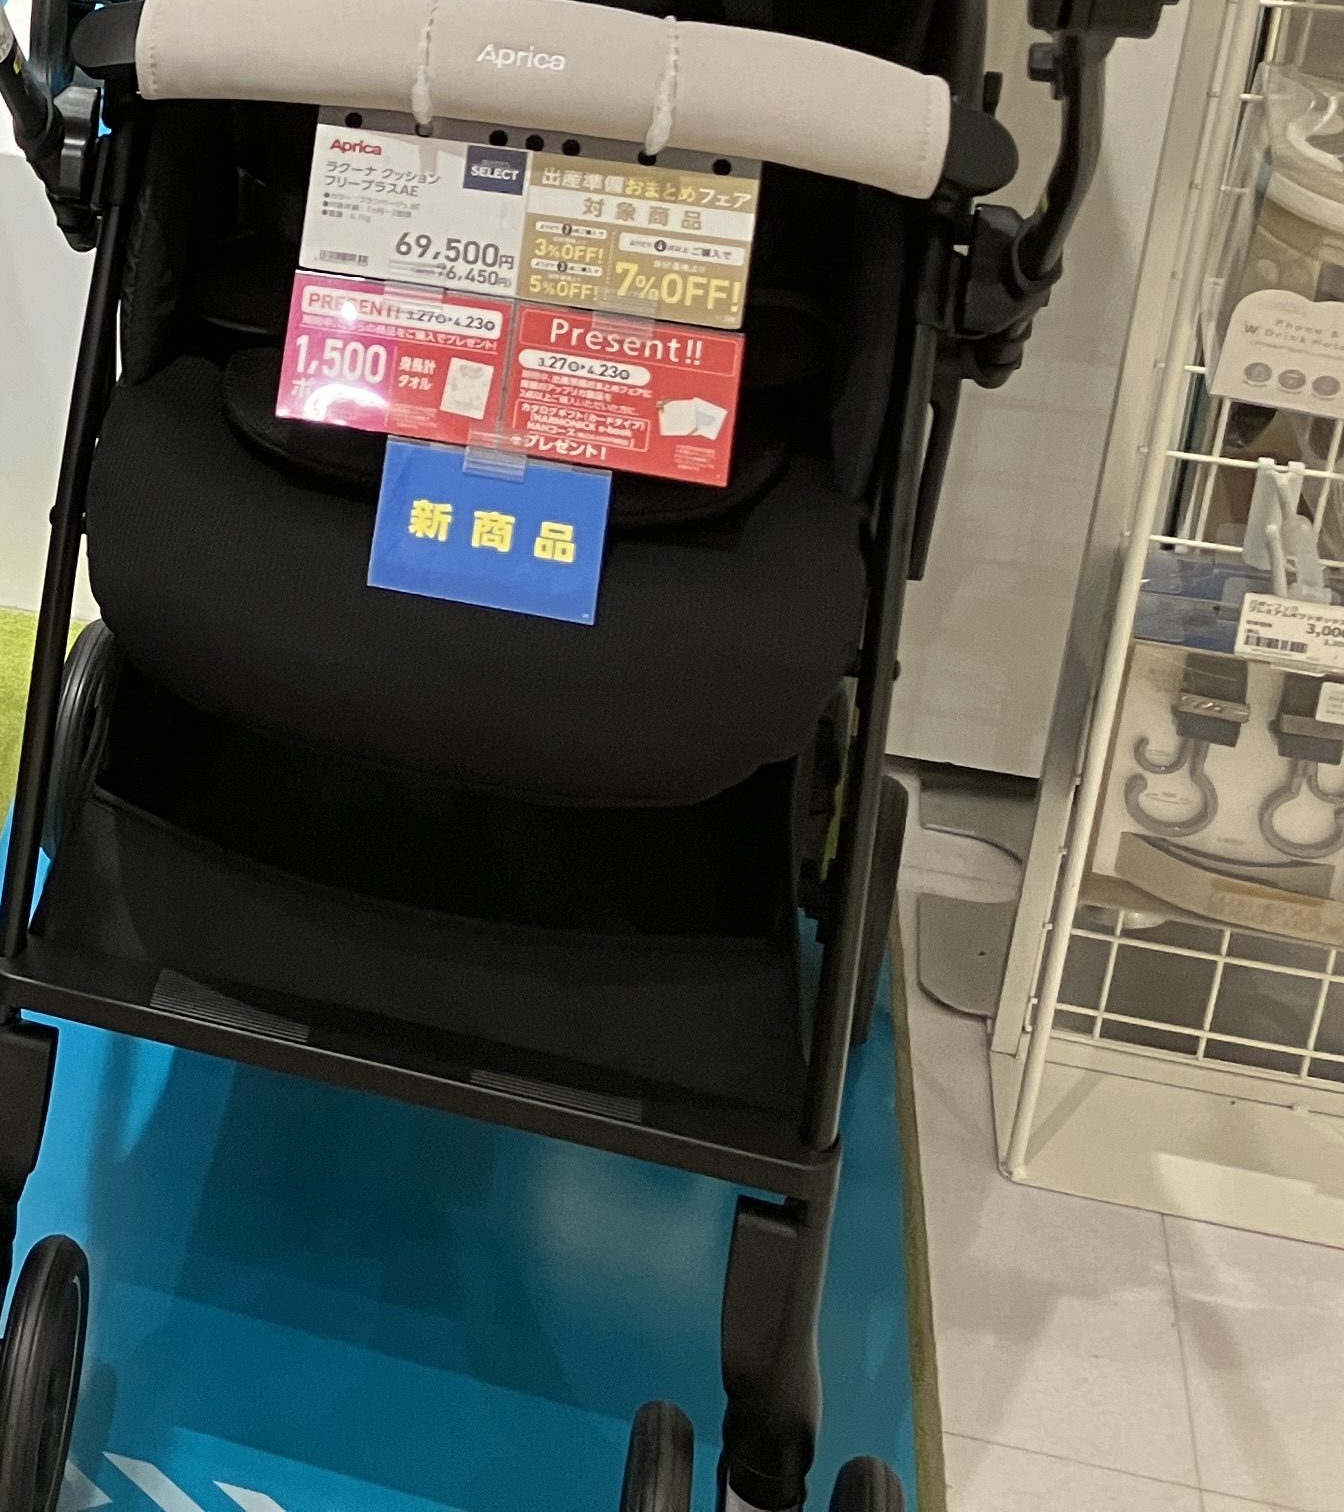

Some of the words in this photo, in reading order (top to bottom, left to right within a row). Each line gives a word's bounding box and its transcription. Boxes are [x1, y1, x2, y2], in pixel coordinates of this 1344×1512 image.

[476, 43, 566, 71] Aprica
[330, 139, 382, 155] Aprica
[324, 175, 419, 197] フリープラスAE
[326, 160, 377, 175] ラクーナ
[382, 168, 441, 185] クッション
[470, 165, 519, 181] SELECT
[542, 167, 751, 208] 出産準備おまとめフェア
[582, 197, 703, 230] 対象商品
[395, 231, 515, 270] 69,500円
[534, 238, 604, 264] 3%OFF!
[529, 274, 599, 301] 5%OFF!
[615, 261, 742, 313] 7%OFF!
[550, 318, 703, 366] Present!!
[295, 335, 387, 383] 1,500
[399, 356, 437, 374] 身長計
[398, 375, 432, 390] タオル
[408, 499, 576, 563] 新商品
